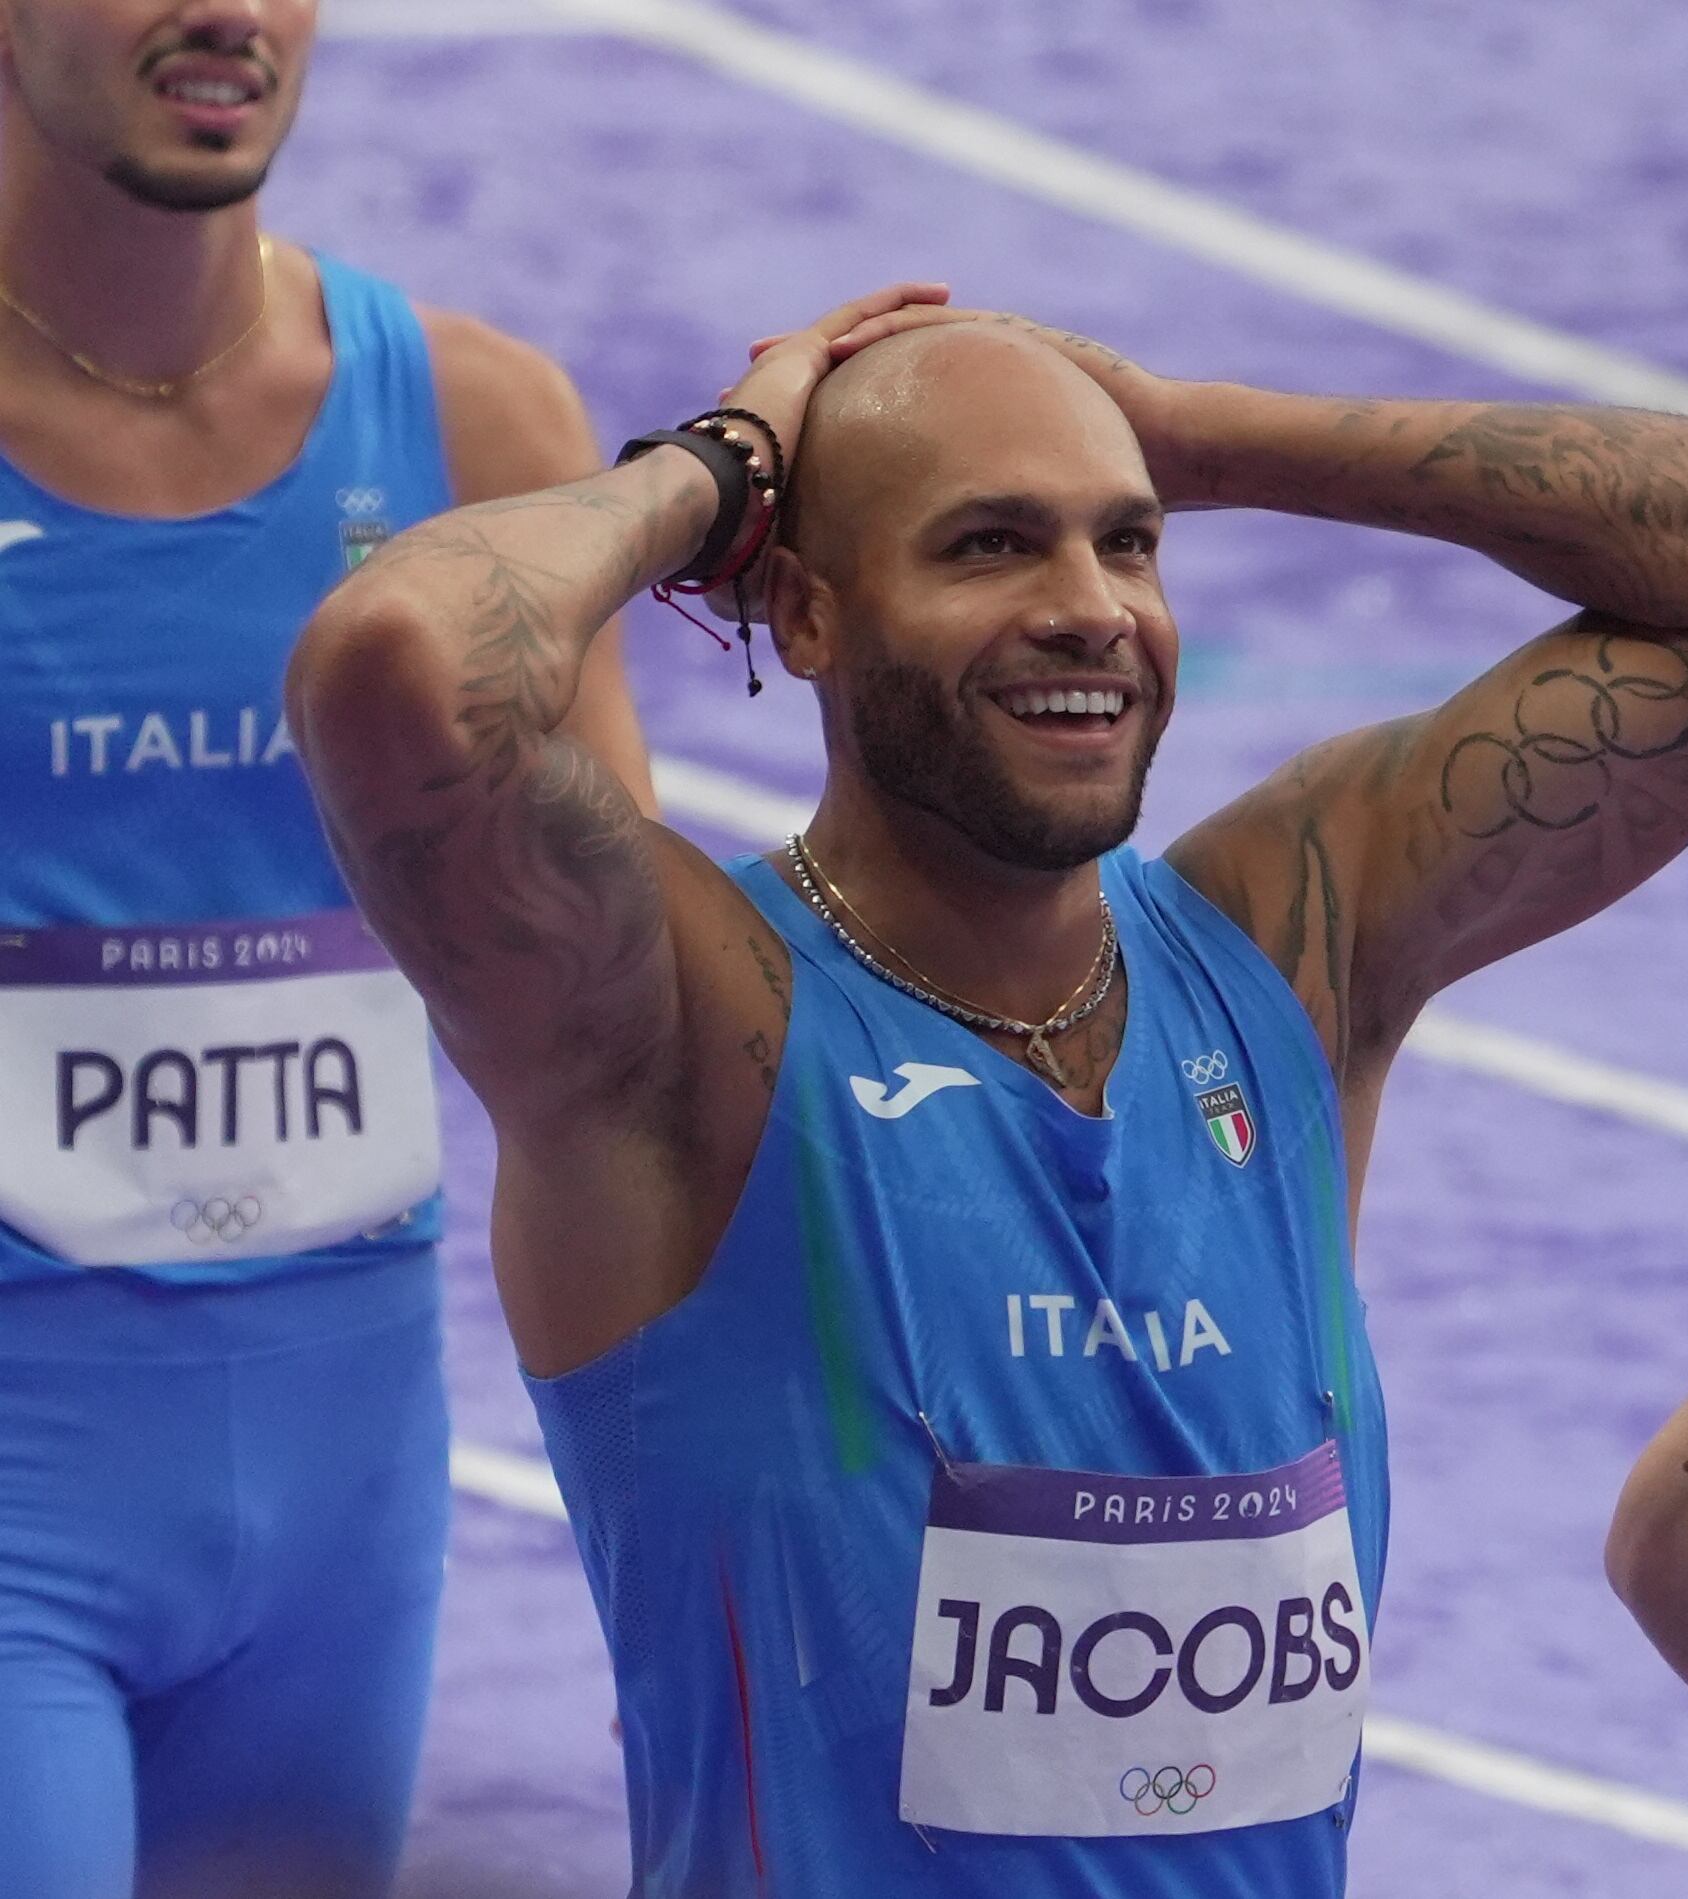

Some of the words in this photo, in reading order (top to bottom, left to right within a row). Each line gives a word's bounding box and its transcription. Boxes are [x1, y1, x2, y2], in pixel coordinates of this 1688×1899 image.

[56, 1036, 365, 1151] PATTA
[1200, 1090, 1239, 1109] ITALIA
[1006, 1294, 1232, 1372] ITAIA
[1212, 1484, 1297, 1520] 2024
[929, 1581, 1361, 1719] JACOBS
